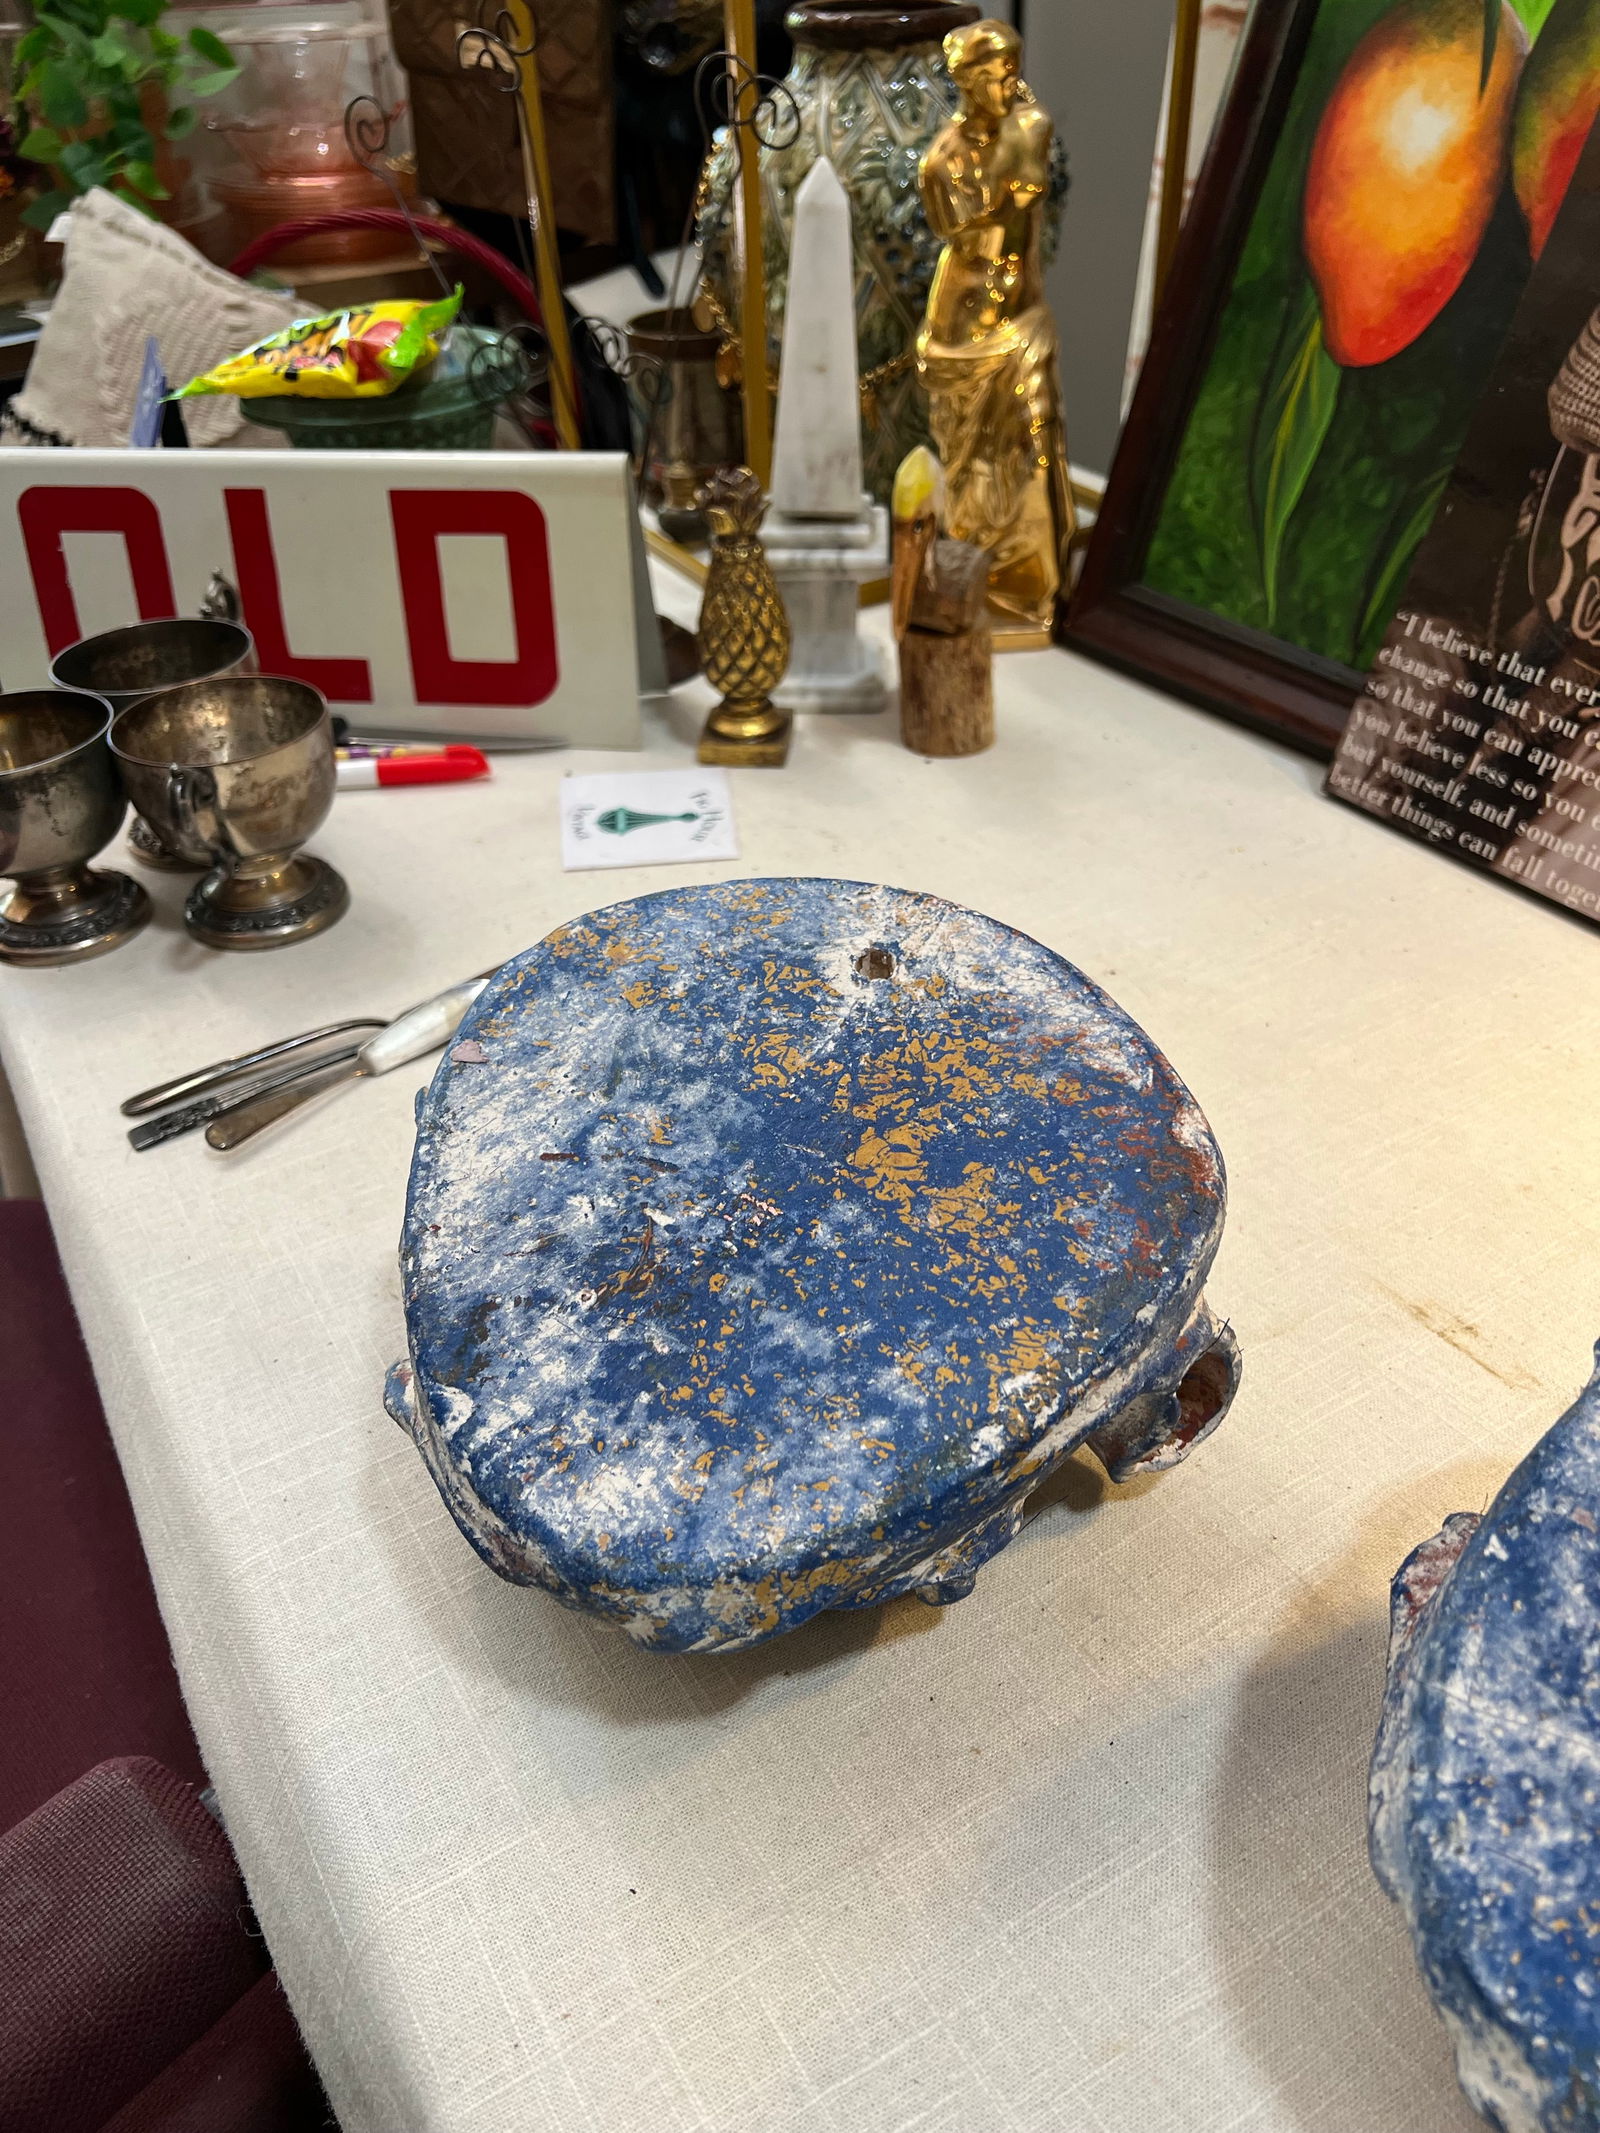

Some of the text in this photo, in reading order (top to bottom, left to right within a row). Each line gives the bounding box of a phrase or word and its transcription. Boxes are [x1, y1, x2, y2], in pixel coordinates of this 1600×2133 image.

[1365, 680, 1389, 699] so
[1392, 686, 1437, 720] that
[1436, 709, 1480, 738] you
[1483, 727, 1526, 757] can
[1379, 644, 1600, 750] change so that you c
[1419, 619, 1493, 666] believe
[1497, 651, 1547, 686] that
[1550, 676, 1600, 718] ever
[1342, 733, 1377, 766] but
[1469, 799, 1517, 830] and
[1350, 711, 1392, 737] you
[1394, 721, 1466, 769] believe
[1468, 751, 1508, 788] less
[1510, 778, 1538, 800] so
[1537, 791, 1586, 823] you
[1330, 763, 1389, 807] better
[1392, 795, 1456, 842] things
[1458, 831, 1499, 861] can
[1502, 845, 1544, 881] fall
